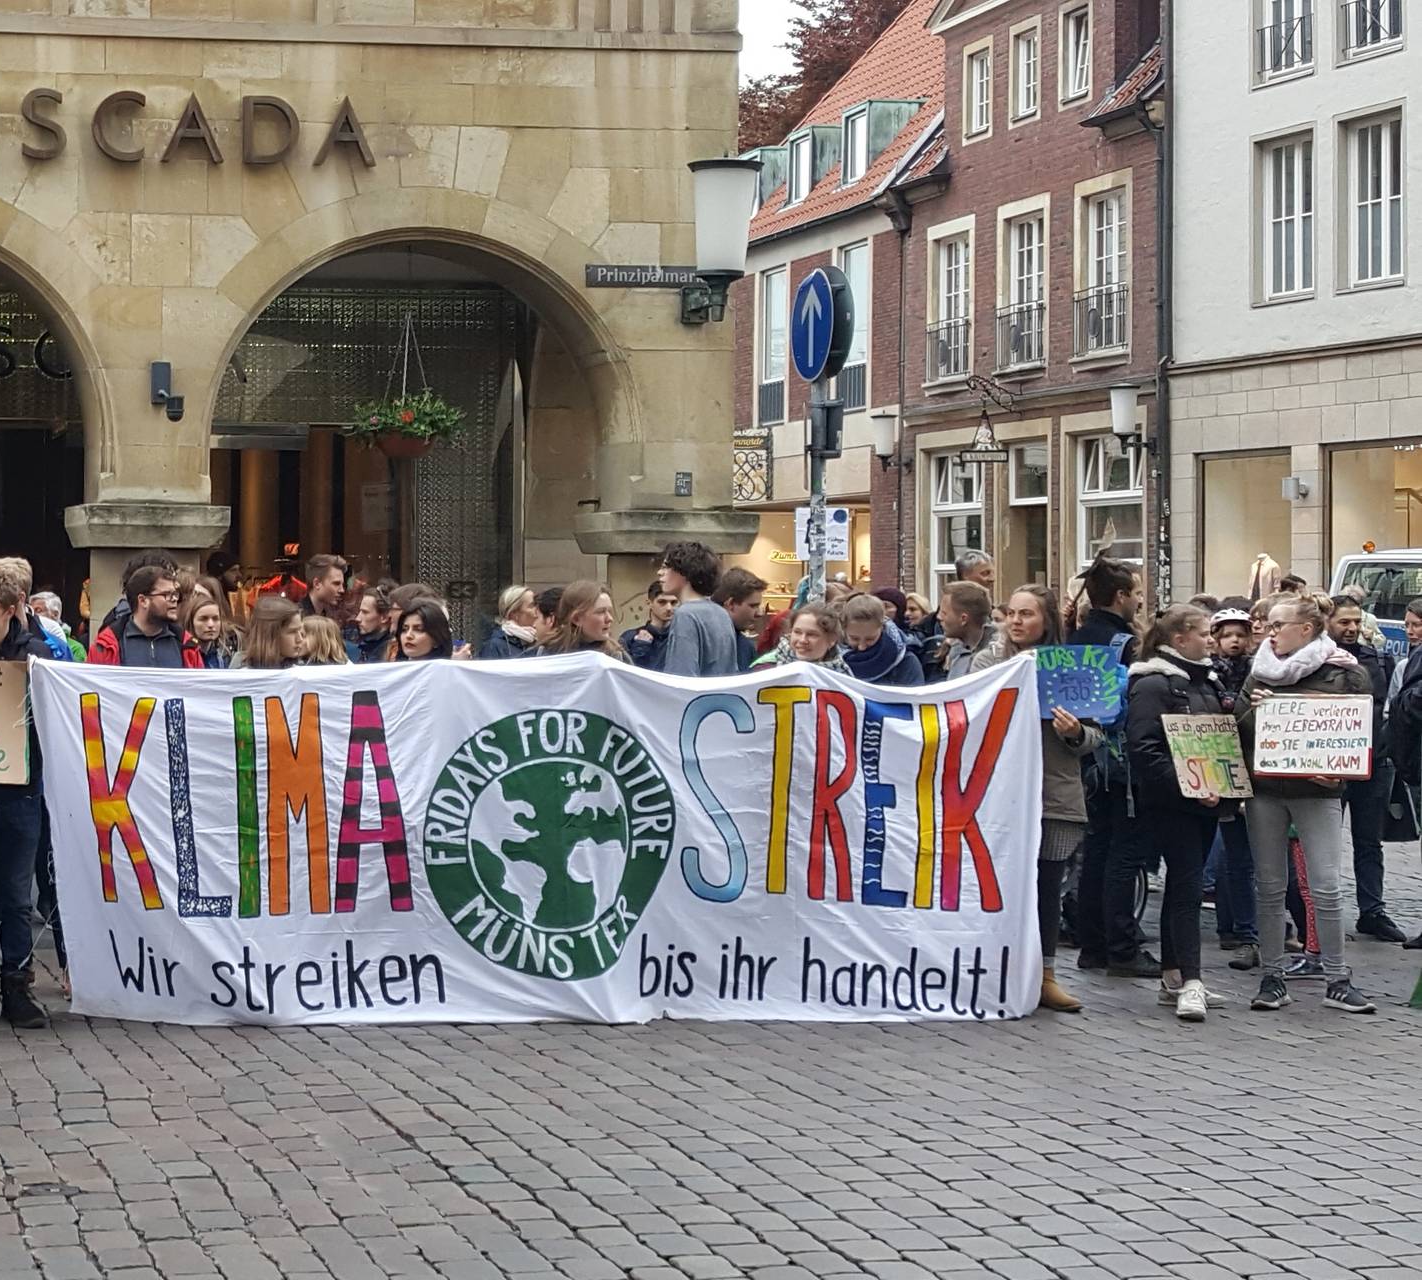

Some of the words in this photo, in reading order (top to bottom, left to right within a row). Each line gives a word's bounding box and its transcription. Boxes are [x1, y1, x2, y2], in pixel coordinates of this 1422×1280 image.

[597, 267, 708, 285] Prinzipalmar
[1261, 701, 1308, 716] TIERE
[1313, 703, 1360, 718] verlieren
[1284, 718, 1363, 734] LEBENSRAUM
[1281, 738, 1300, 751] SIE
[1258, 756, 1279, 769] das
[1282, 756, 1298, 769] JA
[1300, 756, 1324, 770] WOHL
[1326, 754, 1361, 771] KAUM
[425, 728, 510, 867] FRIDAYS
[515, 710, 589, 758] FOR
[598, 724, 674, 860] FUTURE
[78, 689, 415, 920] KLIMA
[678, 684, 1021, 914] STREIK
[108, 928, 181, 998] Wir
[209, 938, 447, 1016] streiken
[638, 932, 698, 998] bis
[718, 936, 778, 1001] ihr
[800, 936, 1012, 1019] handelt!
